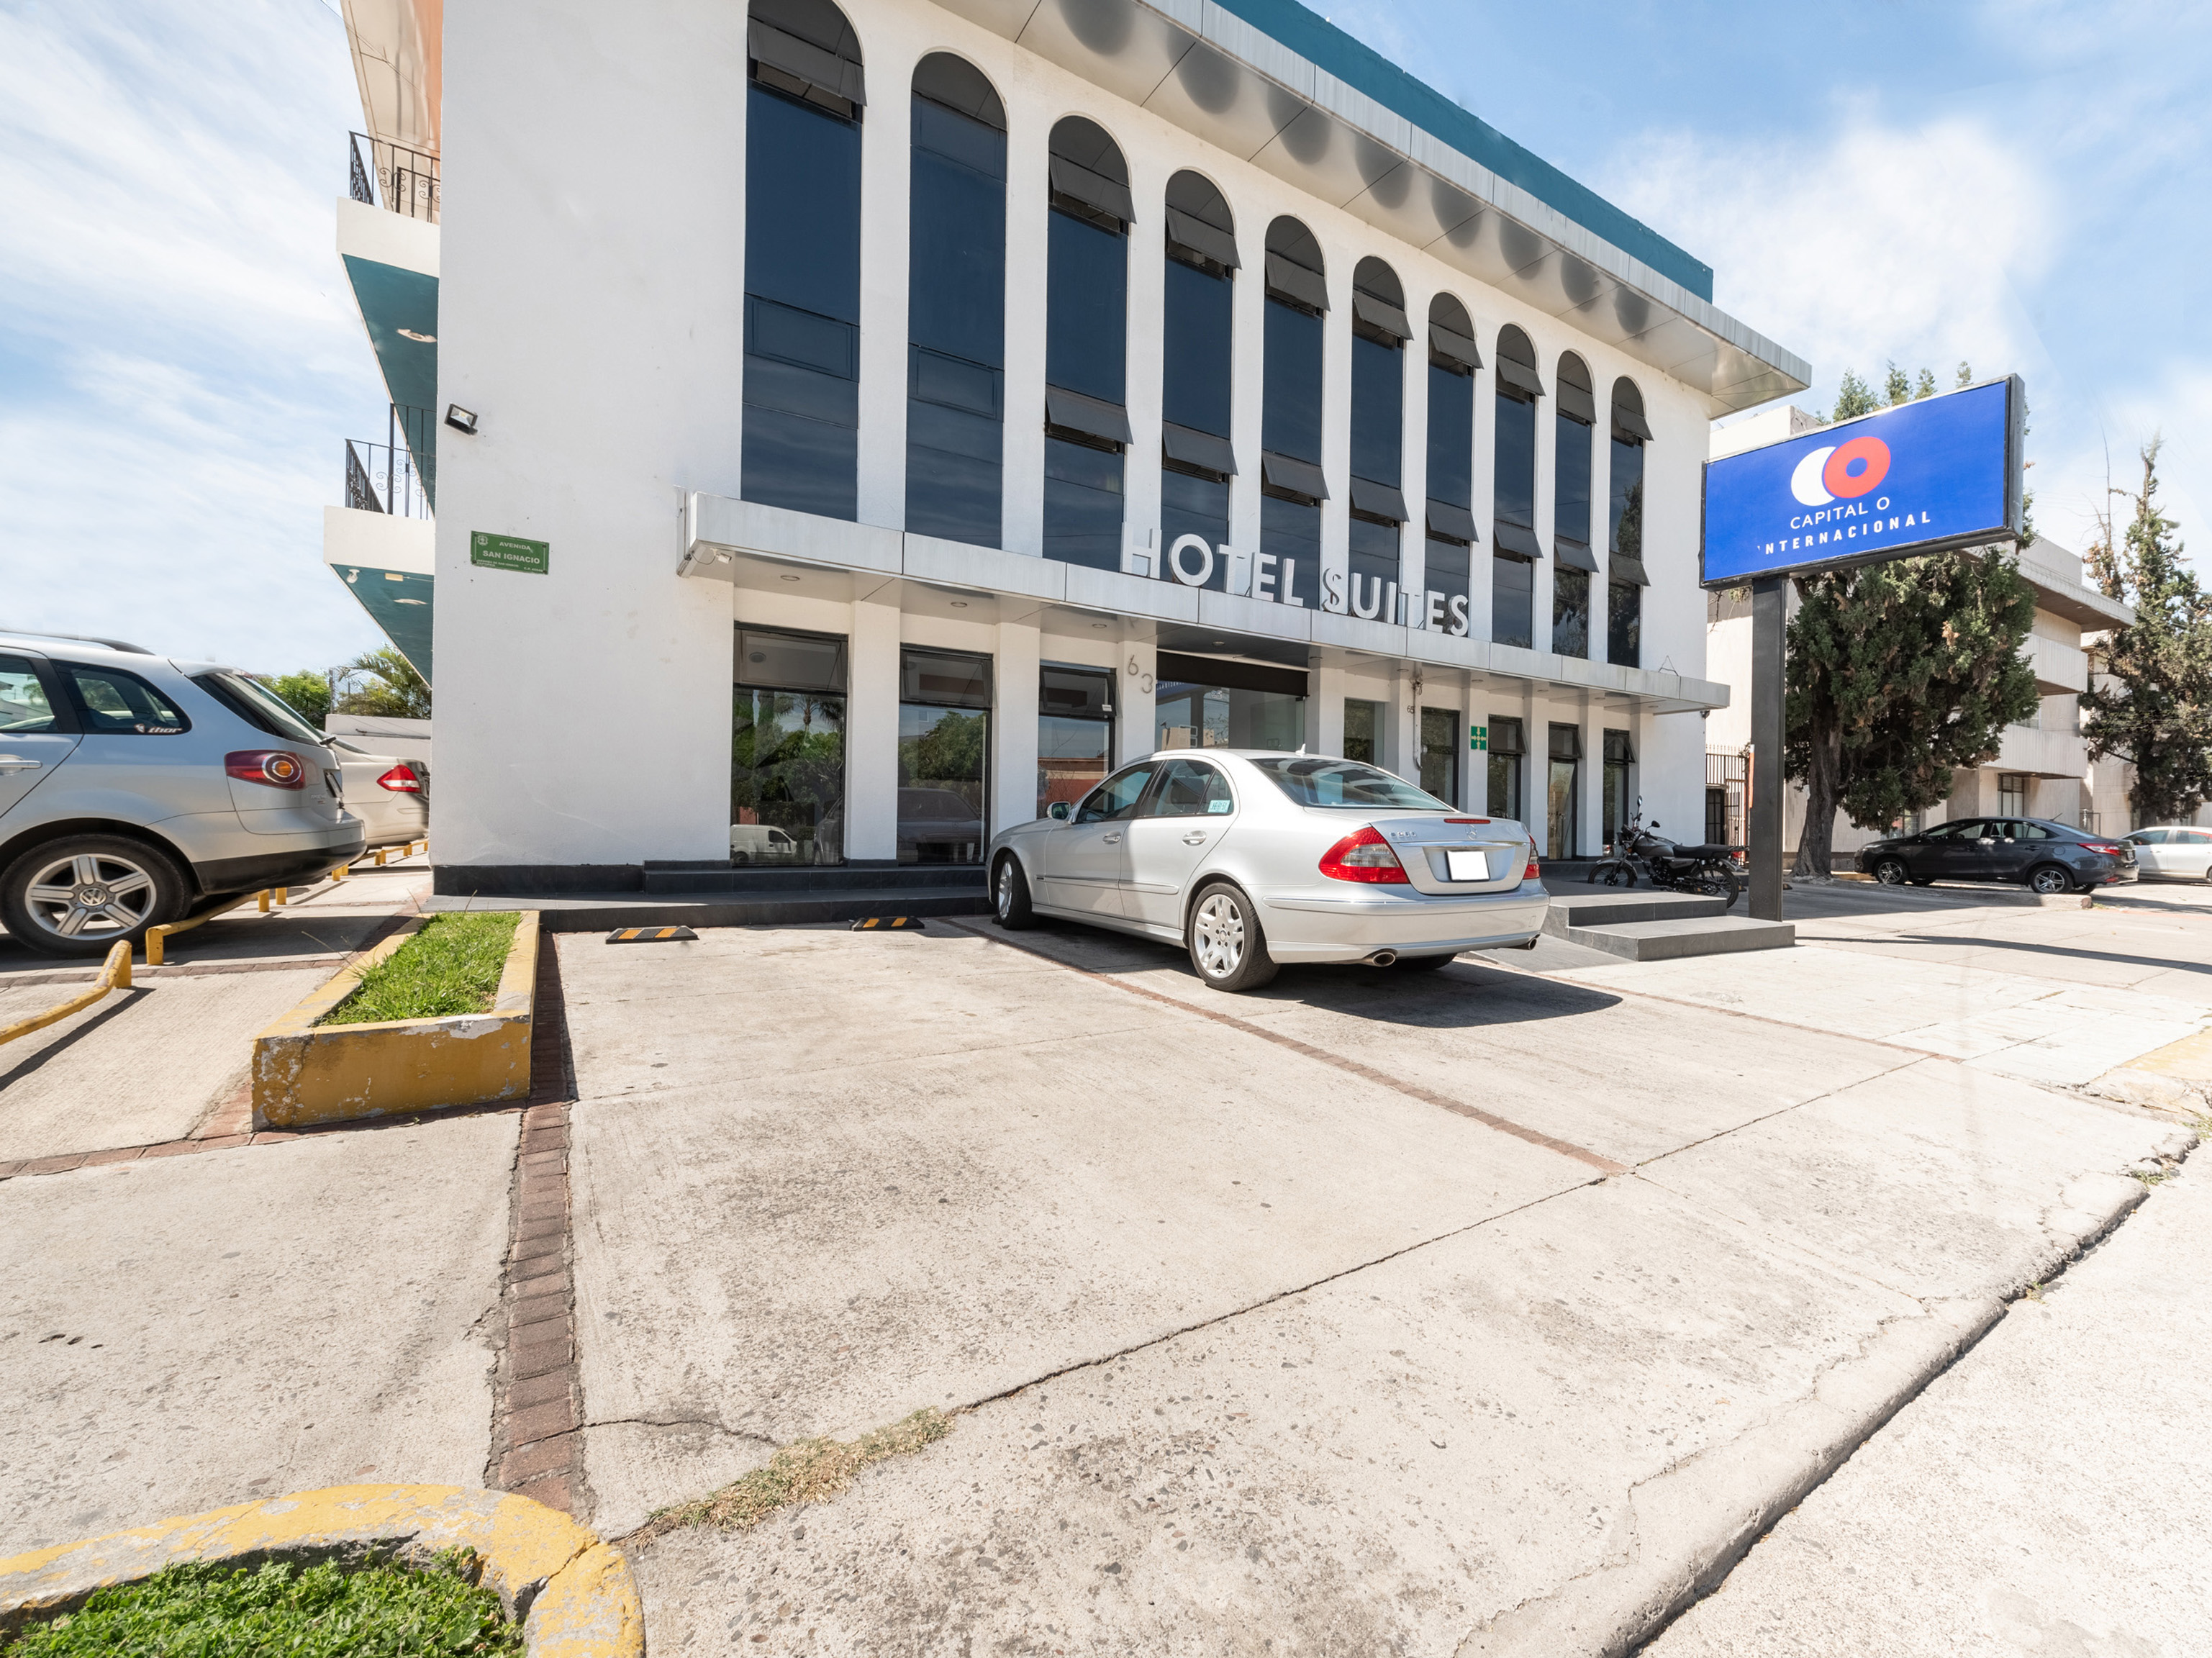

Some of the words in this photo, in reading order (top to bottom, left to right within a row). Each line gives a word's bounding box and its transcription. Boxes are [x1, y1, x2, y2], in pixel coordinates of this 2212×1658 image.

[1757, 511, 1931, 555] NTERNACIONAL
[1790, 502, 1869, 530] CAPITAL
[1876, 497, 1890, 510] O
[483, 551, 502, 559] SAN
[504, 553, 540, 564] IGNACIO
[1120, 521, 1303, 607] HOTEL
[1322, 567, 1469, 637] SUITES
[1128, 654, 1153, 694] 63
